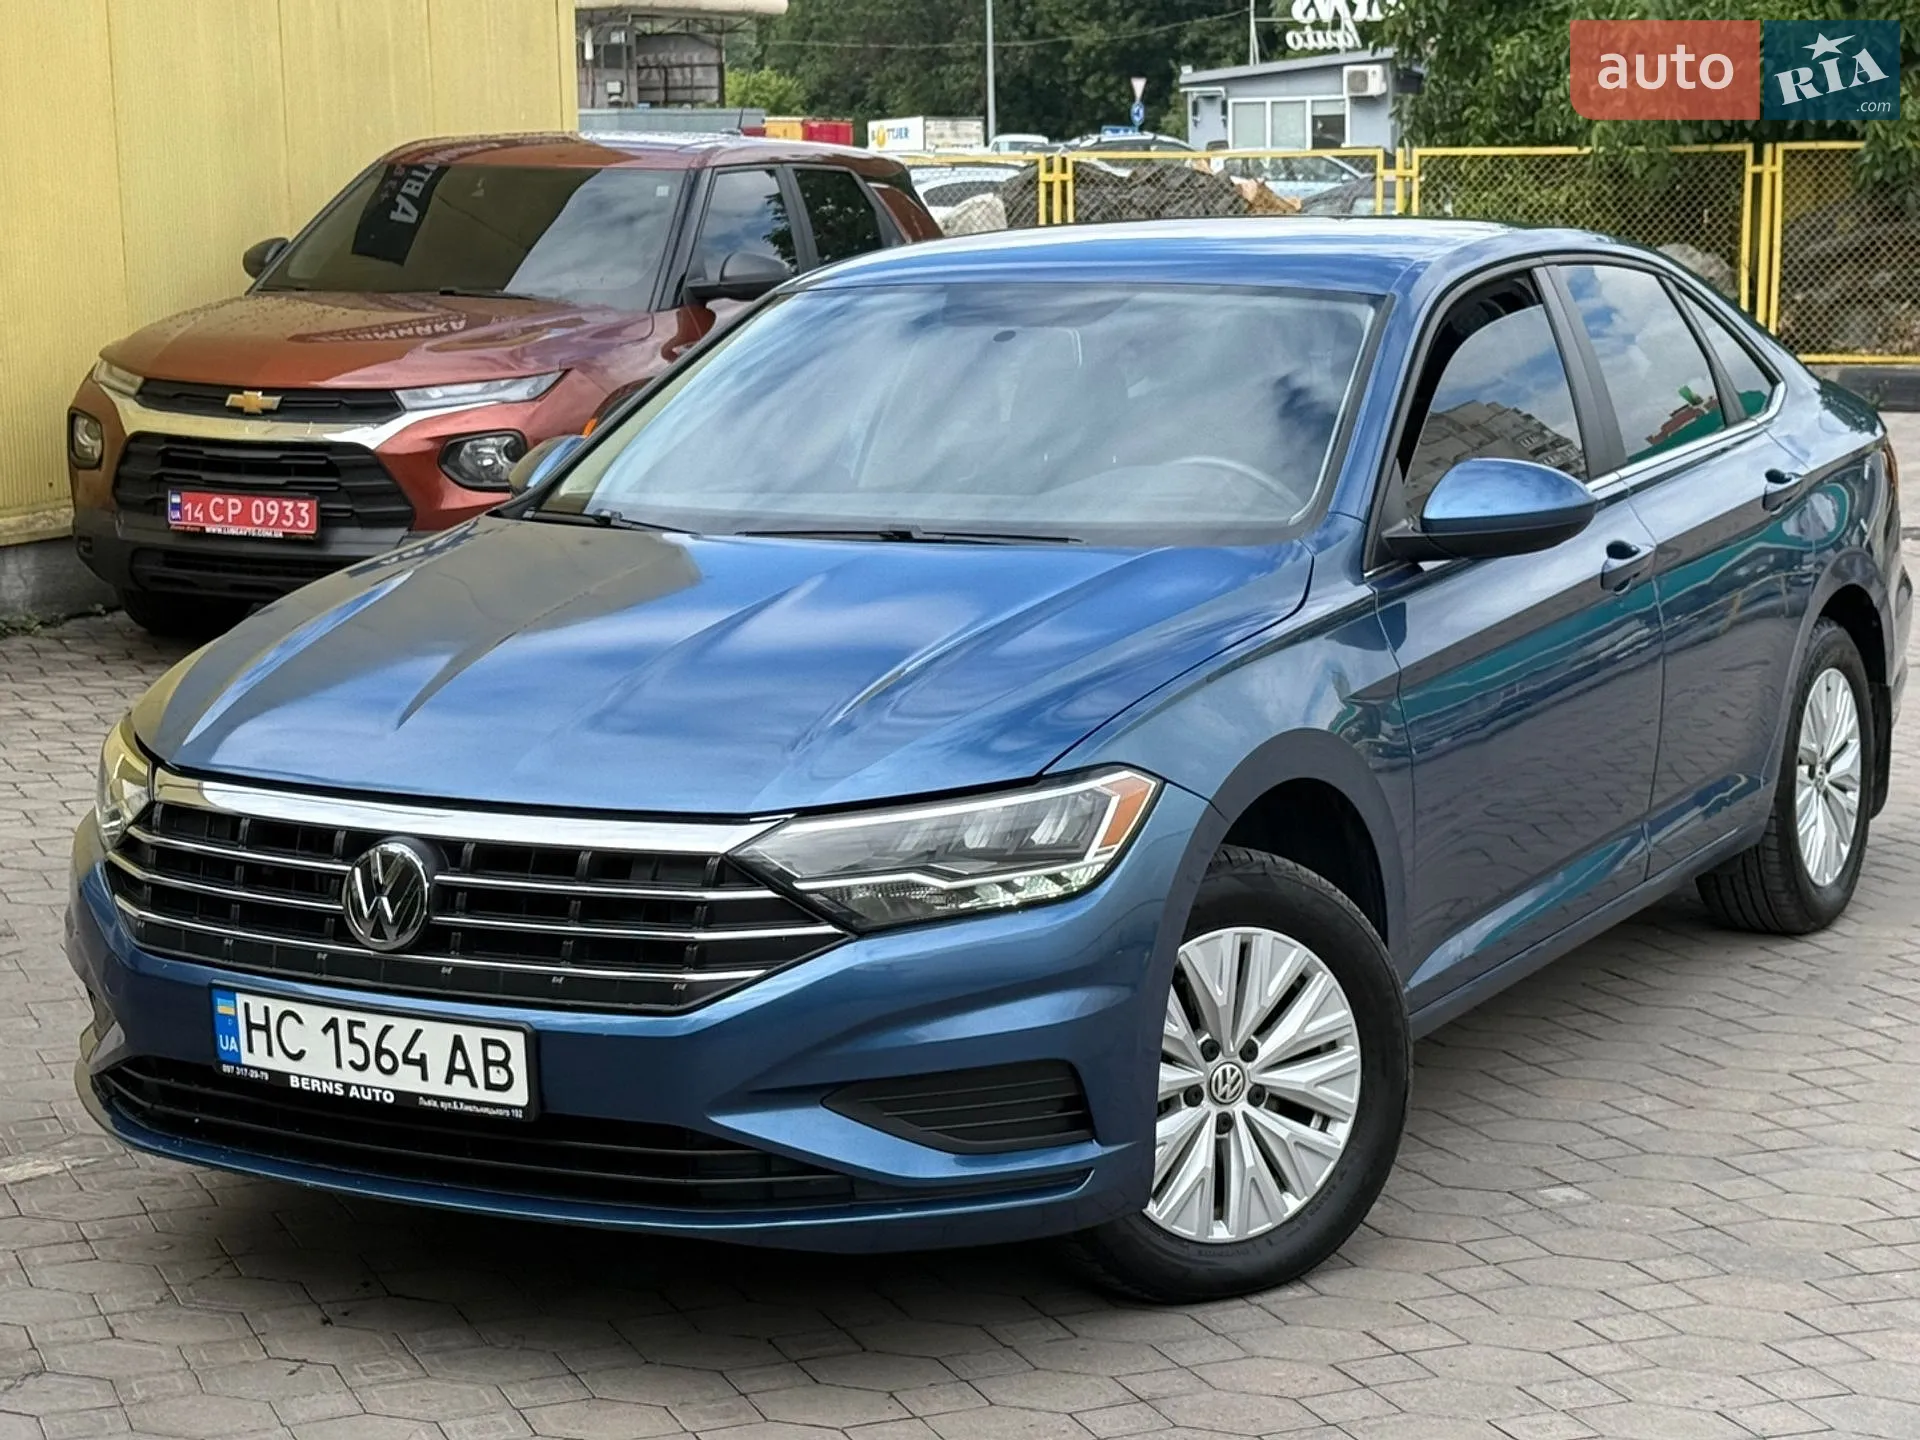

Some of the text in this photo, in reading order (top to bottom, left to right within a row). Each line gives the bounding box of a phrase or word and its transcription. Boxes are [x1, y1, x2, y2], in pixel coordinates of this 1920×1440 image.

[184, 502, 204, 522] 14
[209, 497, 243, 523] CP
[251, 499, 310, 529] 0933
[219, 1001, 515, 1093] UA HC 1564 AB
[289, 1075, 396, 1104] BERNS AUTO
